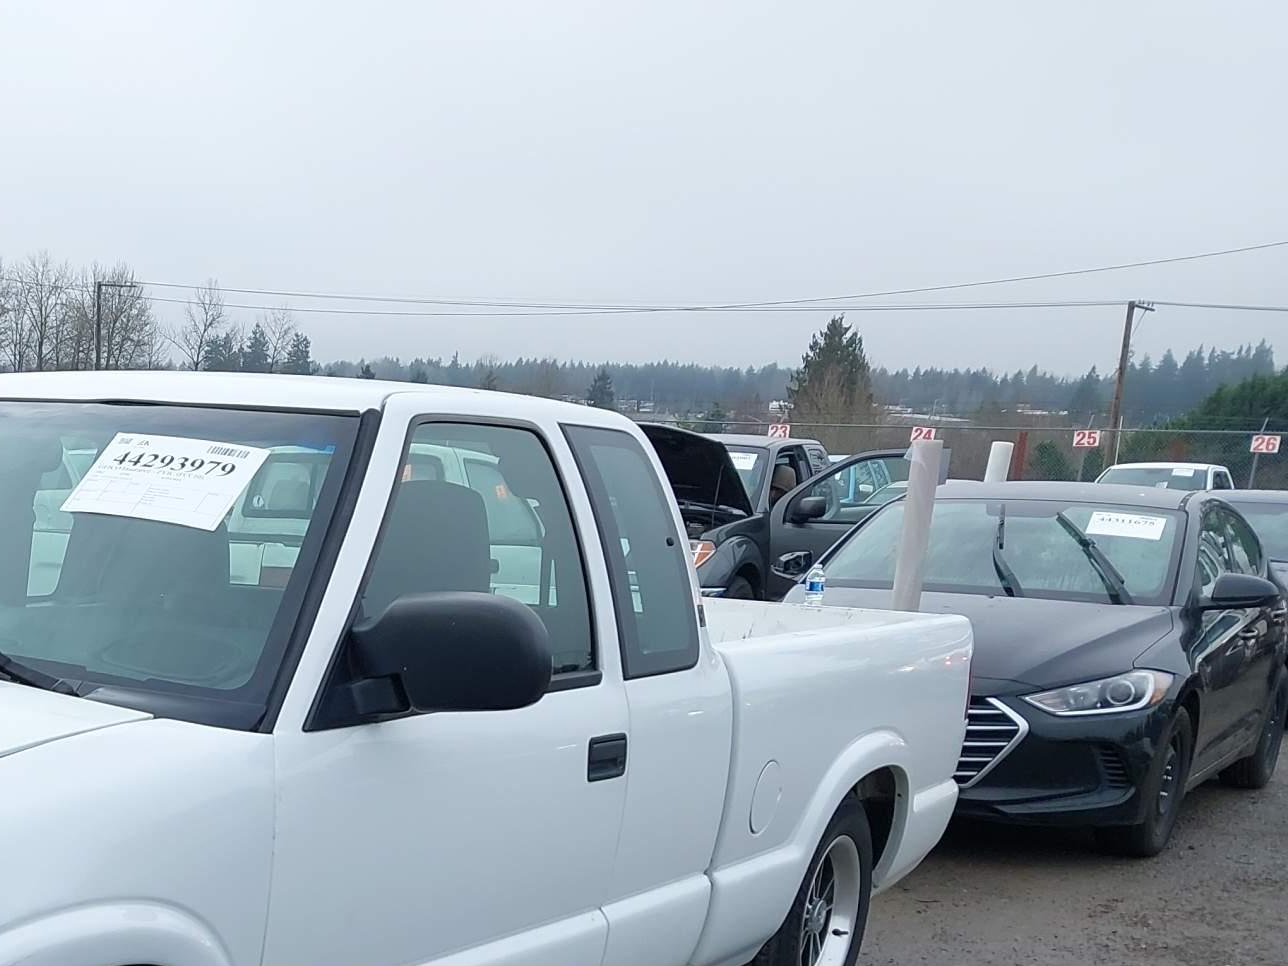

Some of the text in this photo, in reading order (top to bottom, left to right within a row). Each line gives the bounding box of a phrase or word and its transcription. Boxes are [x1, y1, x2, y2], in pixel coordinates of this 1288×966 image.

[769, 425, 788, 438] 23
[912, 428, 932, 440] 24
[1075, 431, 1098, 446] 25
[1253, 437, 1278, 451] 26
[112, 450, 236, 477] 44293979
